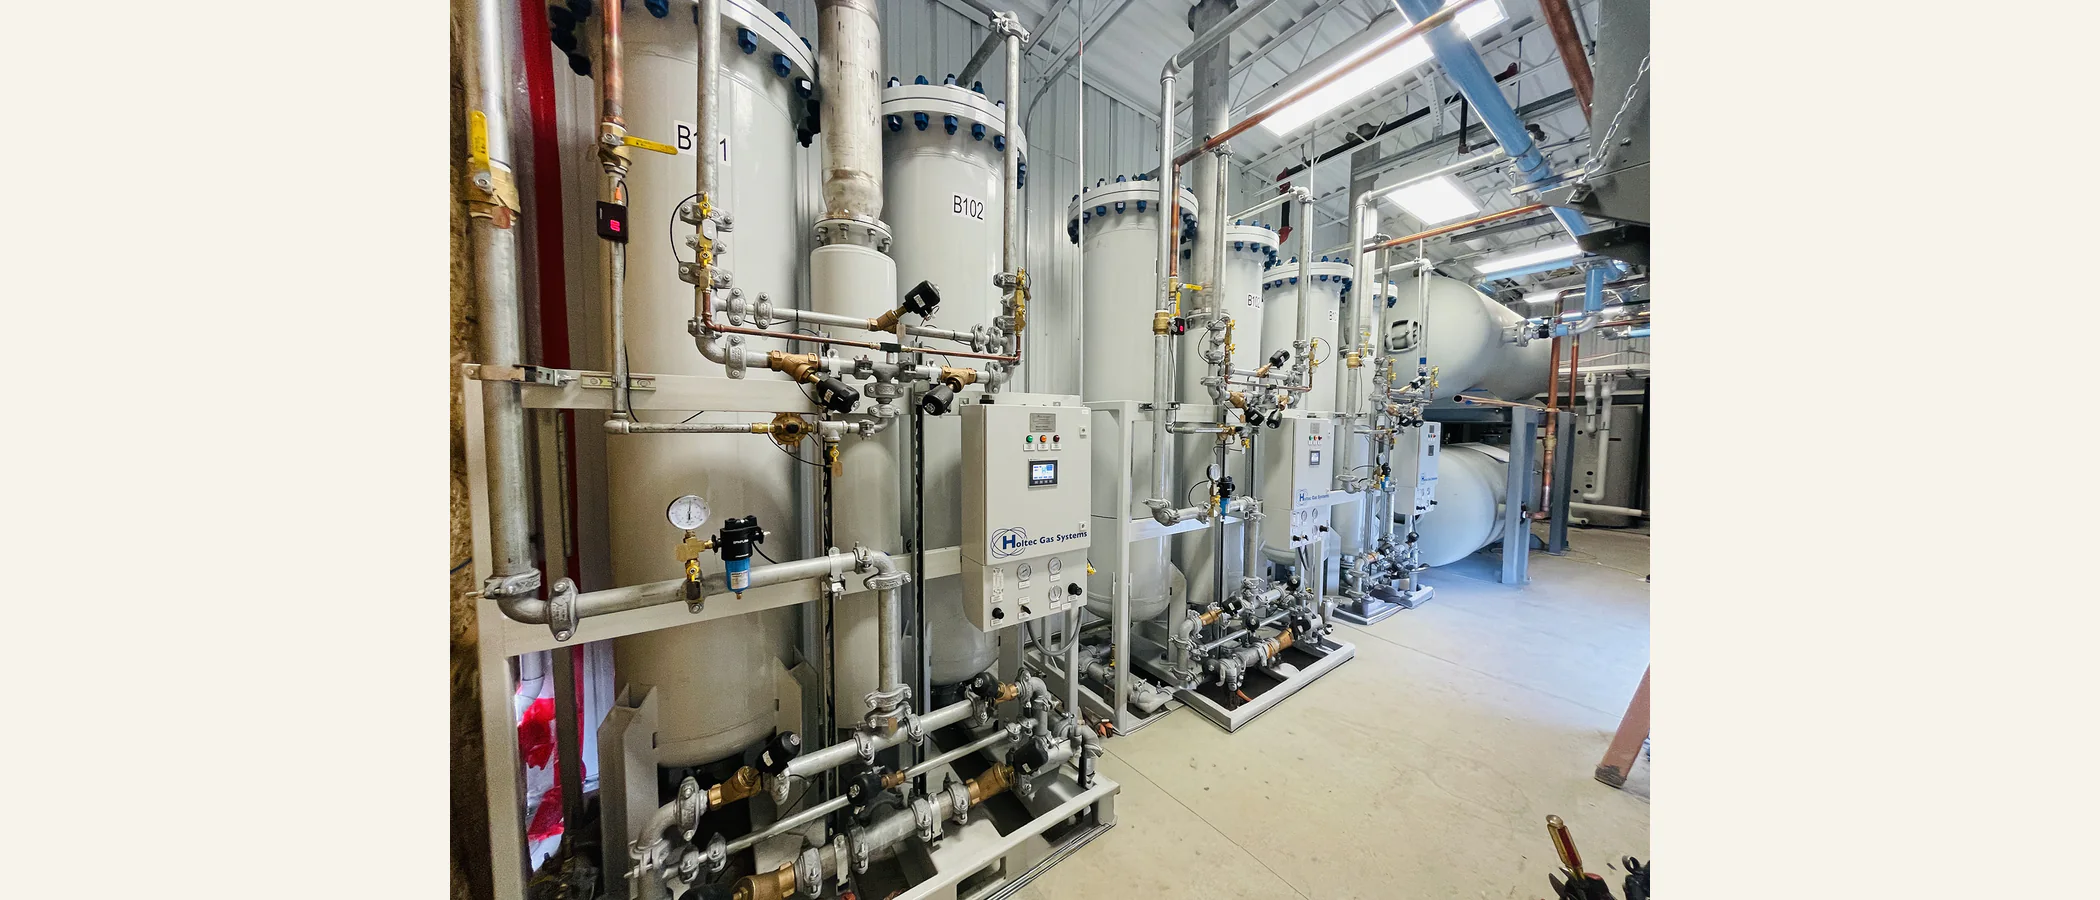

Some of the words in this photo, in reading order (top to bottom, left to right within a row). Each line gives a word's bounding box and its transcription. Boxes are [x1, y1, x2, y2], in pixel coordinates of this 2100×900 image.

[677, 124, 727, 162] B1
[953, 195, 984, 220] B102
[1002, 534, 1037, 550] Holtec
[1040, 536, 1054, 544] Gas
[1056, 531, 1088, 542] Systems
